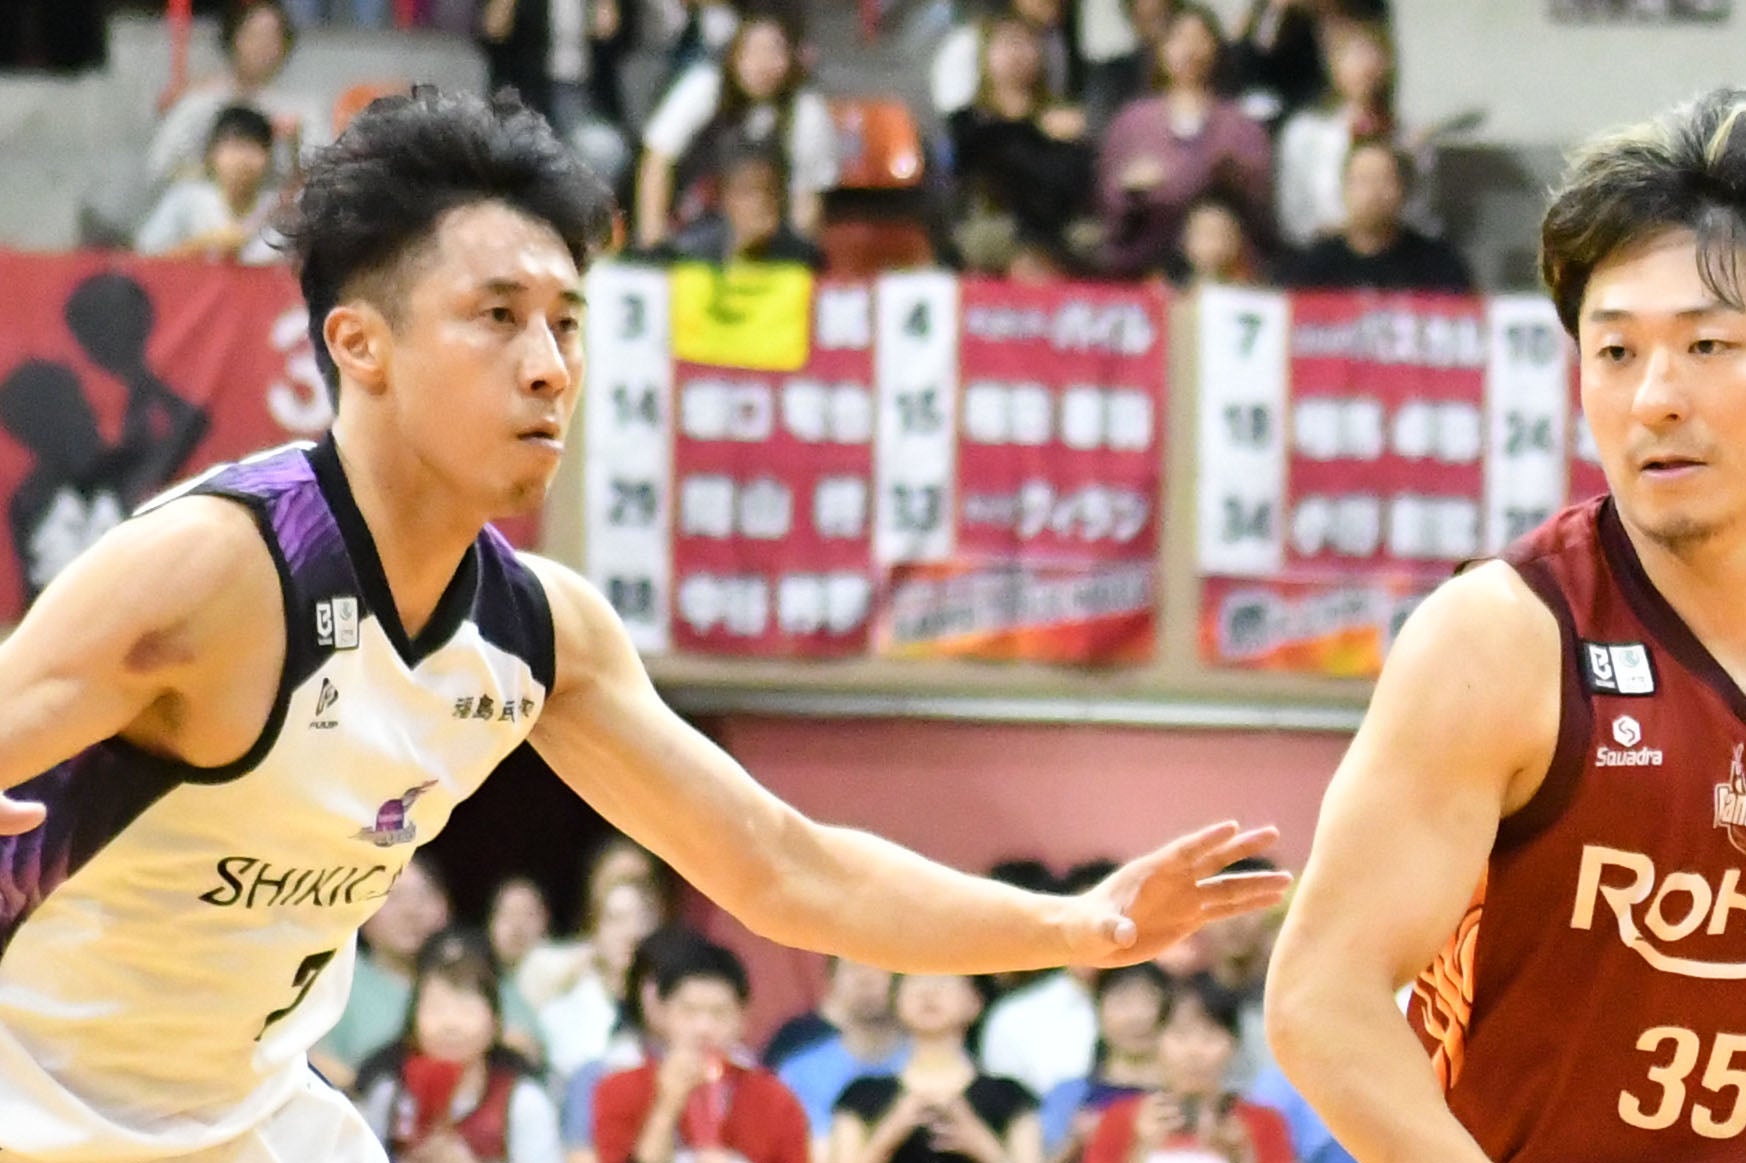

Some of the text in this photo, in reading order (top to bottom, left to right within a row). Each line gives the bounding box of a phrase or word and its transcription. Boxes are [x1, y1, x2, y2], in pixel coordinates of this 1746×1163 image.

[904, 300, 933, 341] 4
[1236, 312, 1263, 358] 7
[1595, 747, 1663, 768] Squadra
